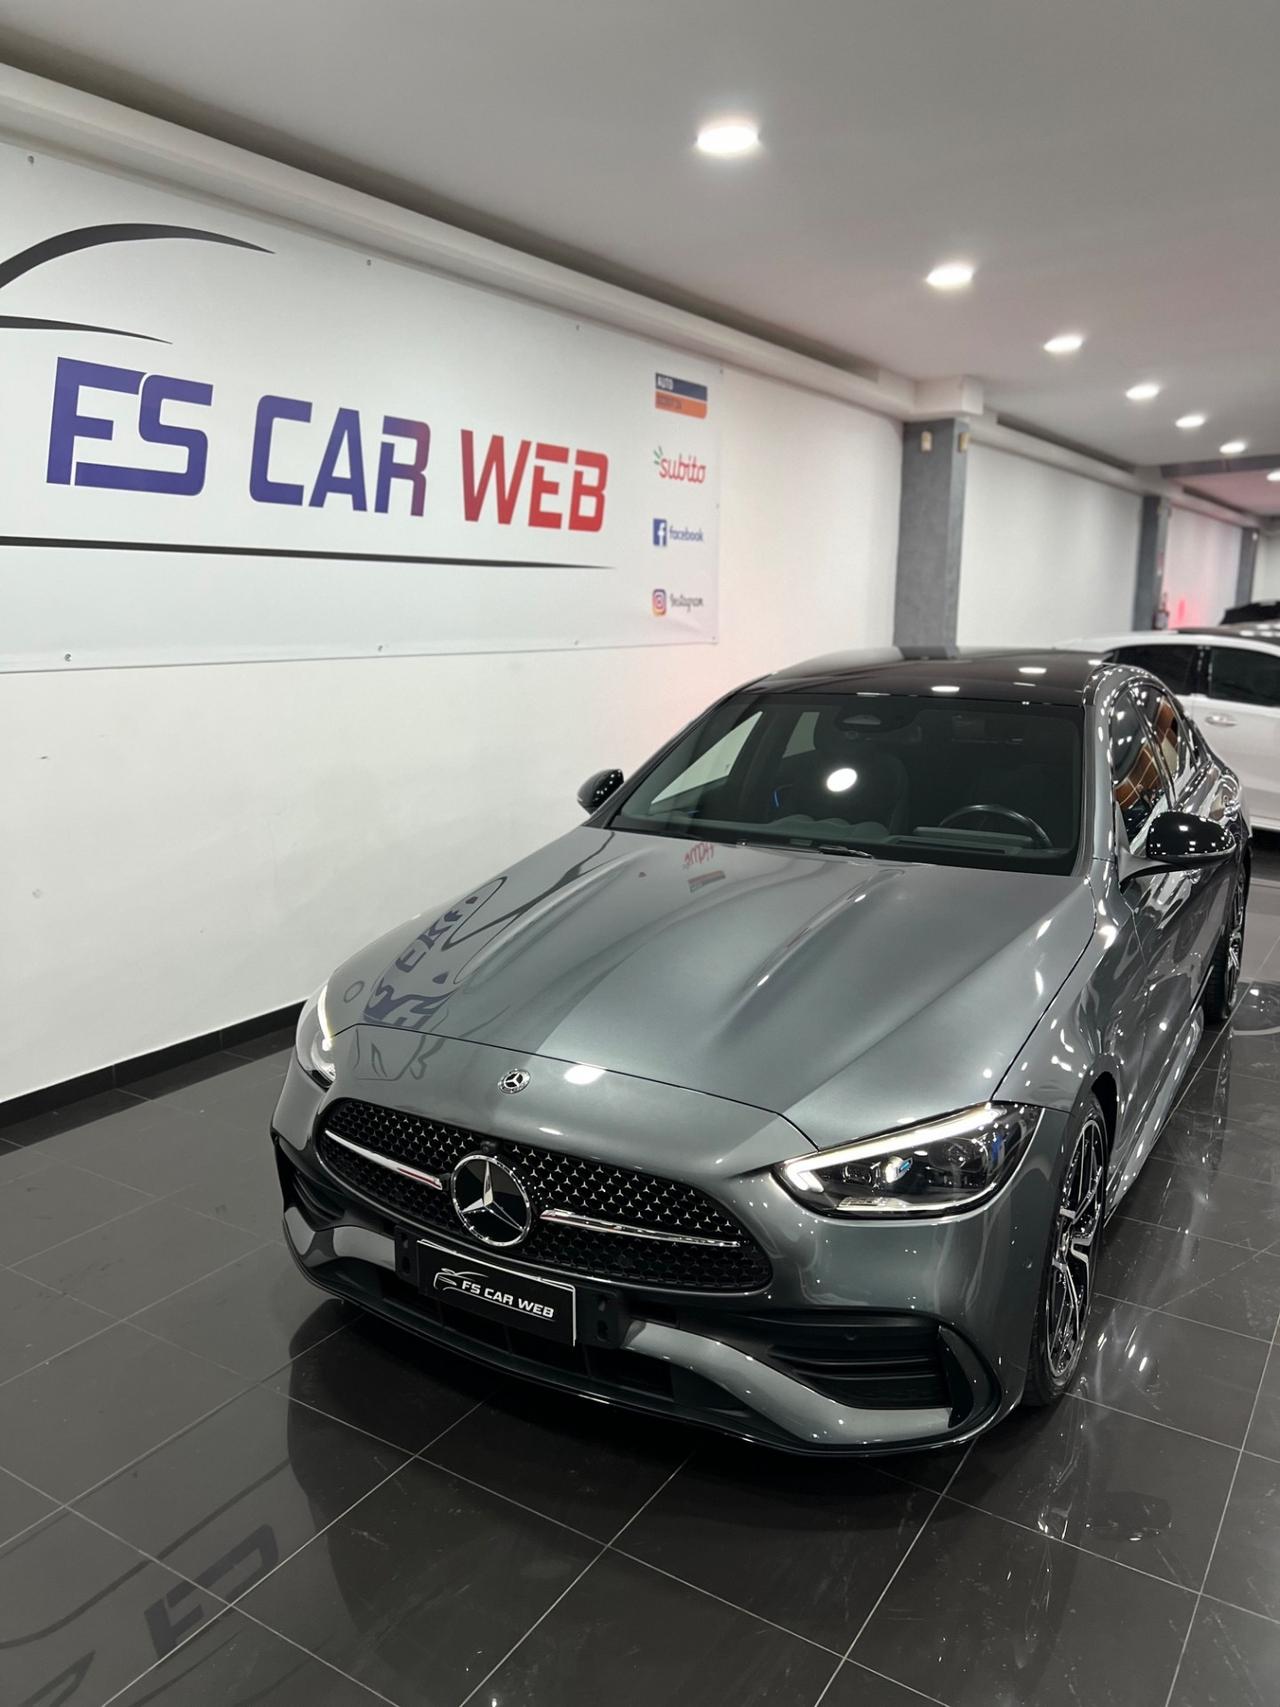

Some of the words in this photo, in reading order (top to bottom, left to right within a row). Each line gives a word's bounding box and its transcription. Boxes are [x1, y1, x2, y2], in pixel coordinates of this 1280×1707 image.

[249, 395, 431, 517] CAR
[460, 429, 609, 533] WEB
[659, 452, 706, 484] subito
[669, 524, 704, 541] facebook
[484, 1288, 514, 1305] CAR
[518, 1298, 555, 1318] WEB
